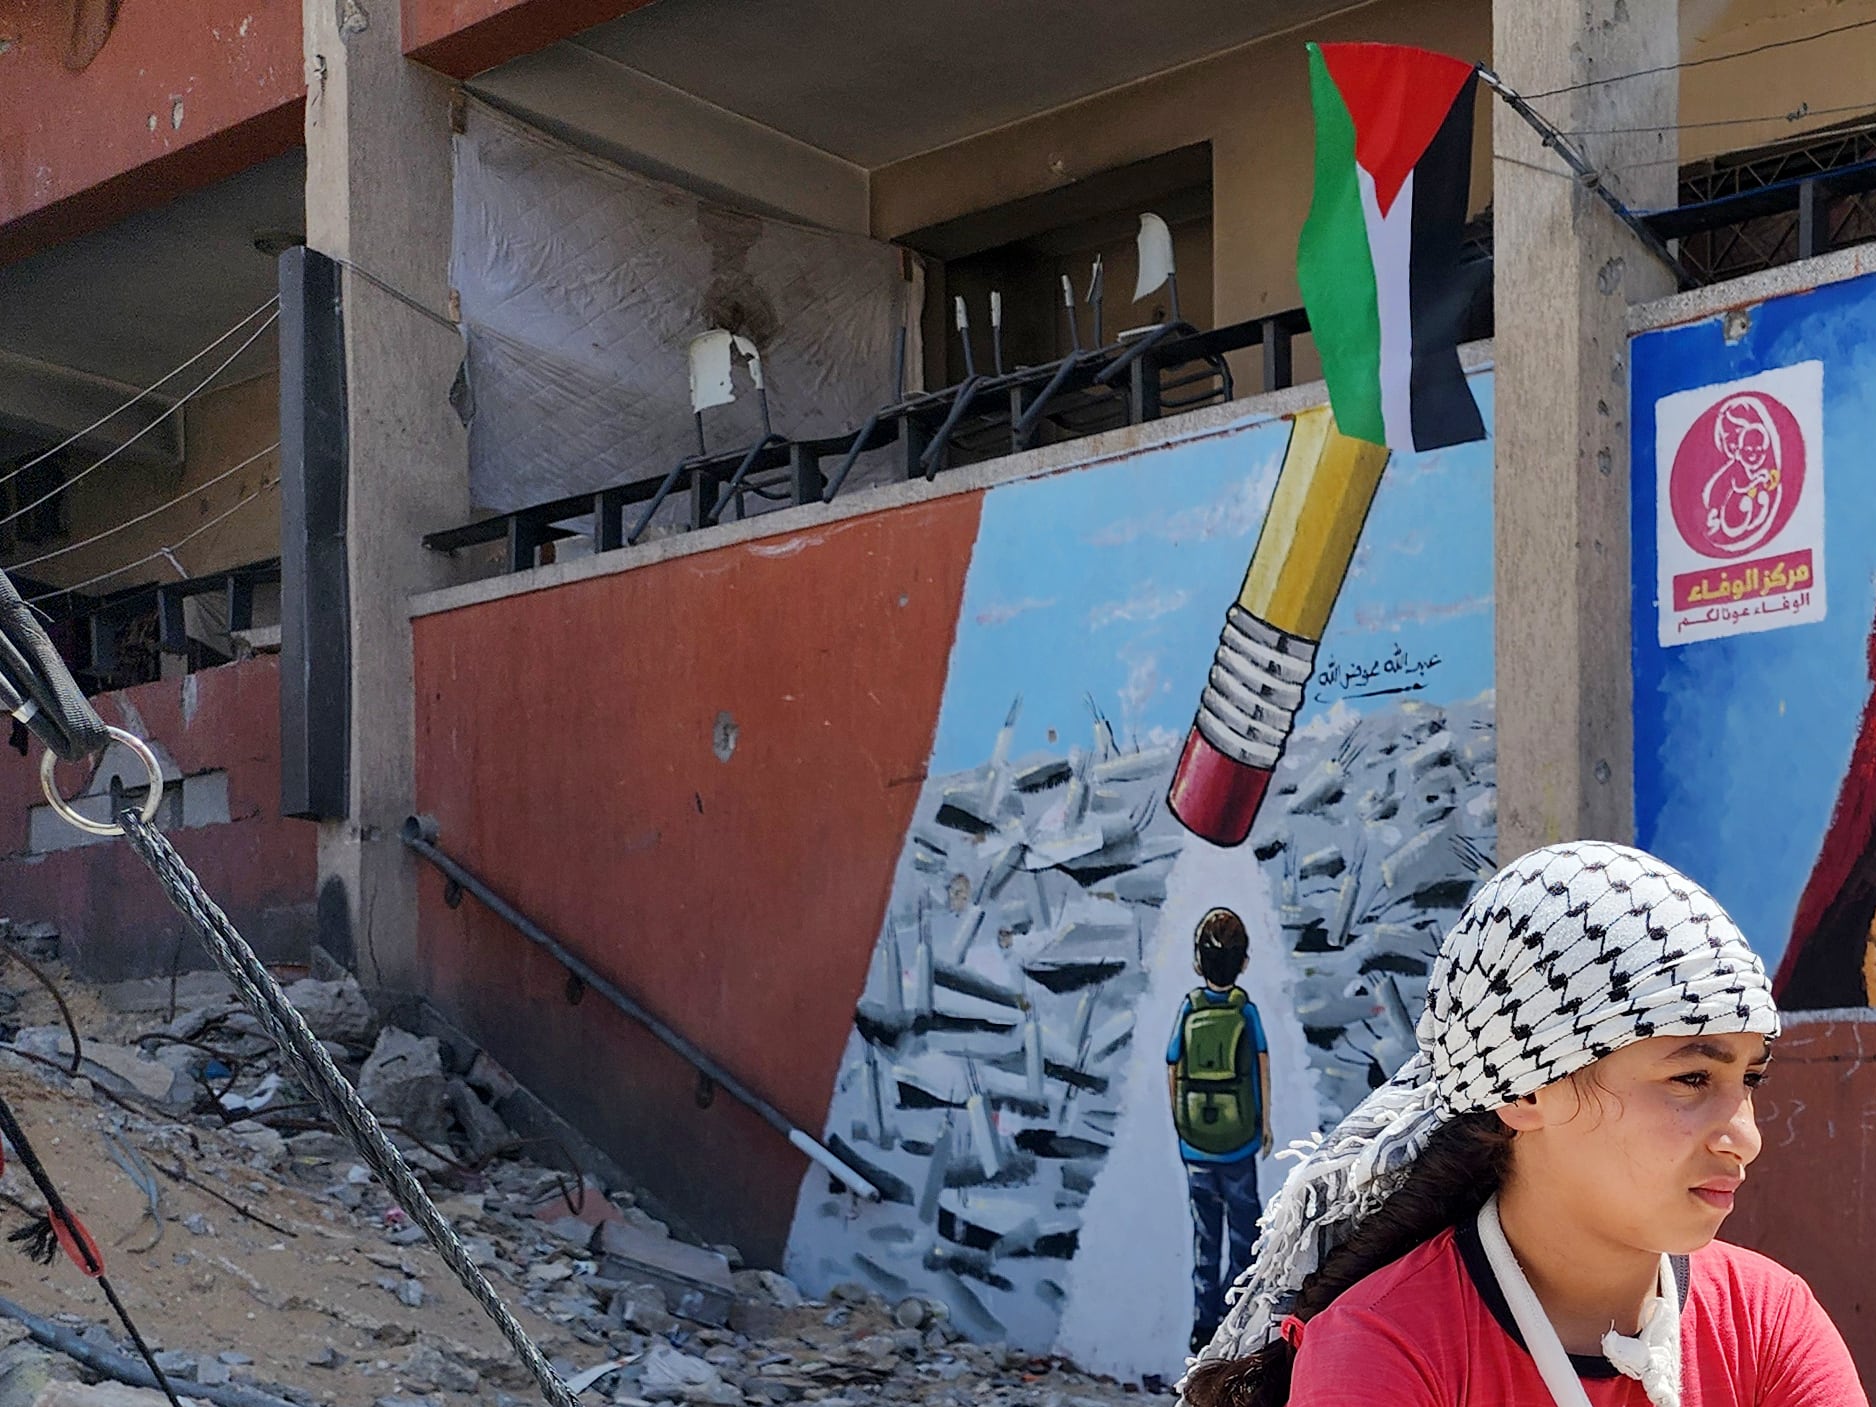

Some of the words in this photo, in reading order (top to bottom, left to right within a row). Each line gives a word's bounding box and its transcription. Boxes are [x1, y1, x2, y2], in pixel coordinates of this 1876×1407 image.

[1687, 567, 1759, 603] الوفاء
[1761, 562, 1810, 595] مركز
[1677, 607, 1720, 633] لكم
[1405, 653, 1442, 677] عبد
